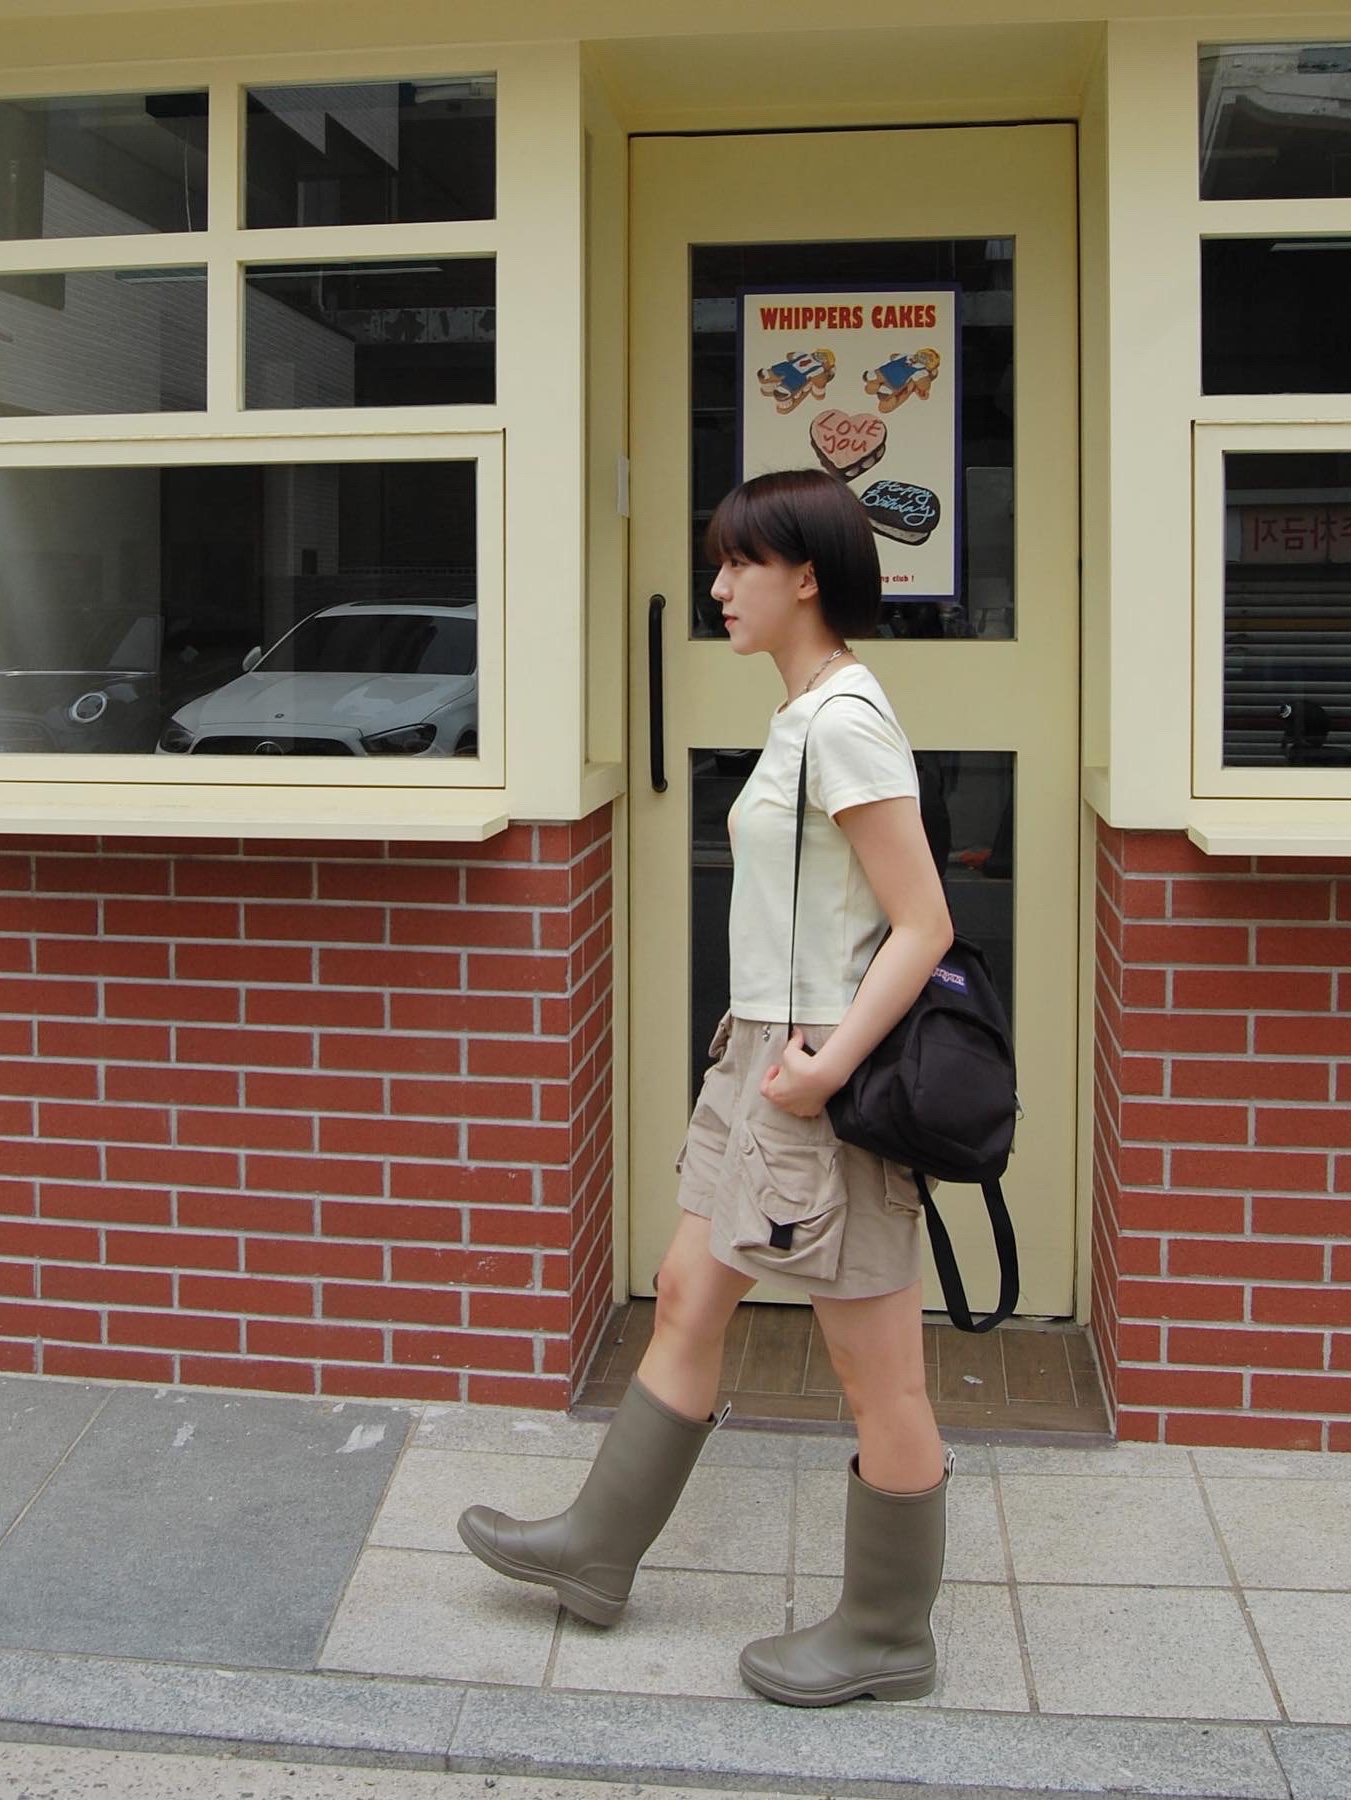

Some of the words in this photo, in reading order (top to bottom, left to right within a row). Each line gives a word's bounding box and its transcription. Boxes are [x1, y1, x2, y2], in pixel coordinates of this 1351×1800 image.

[761, 306, 863, 330] WHIPPERS
[871, 305, 936, 328] CAKES
[817, 412, 882, 437] LOVE
[877, 481, 933, 505] Happy
[860, 489, 935, 526] Birthday
